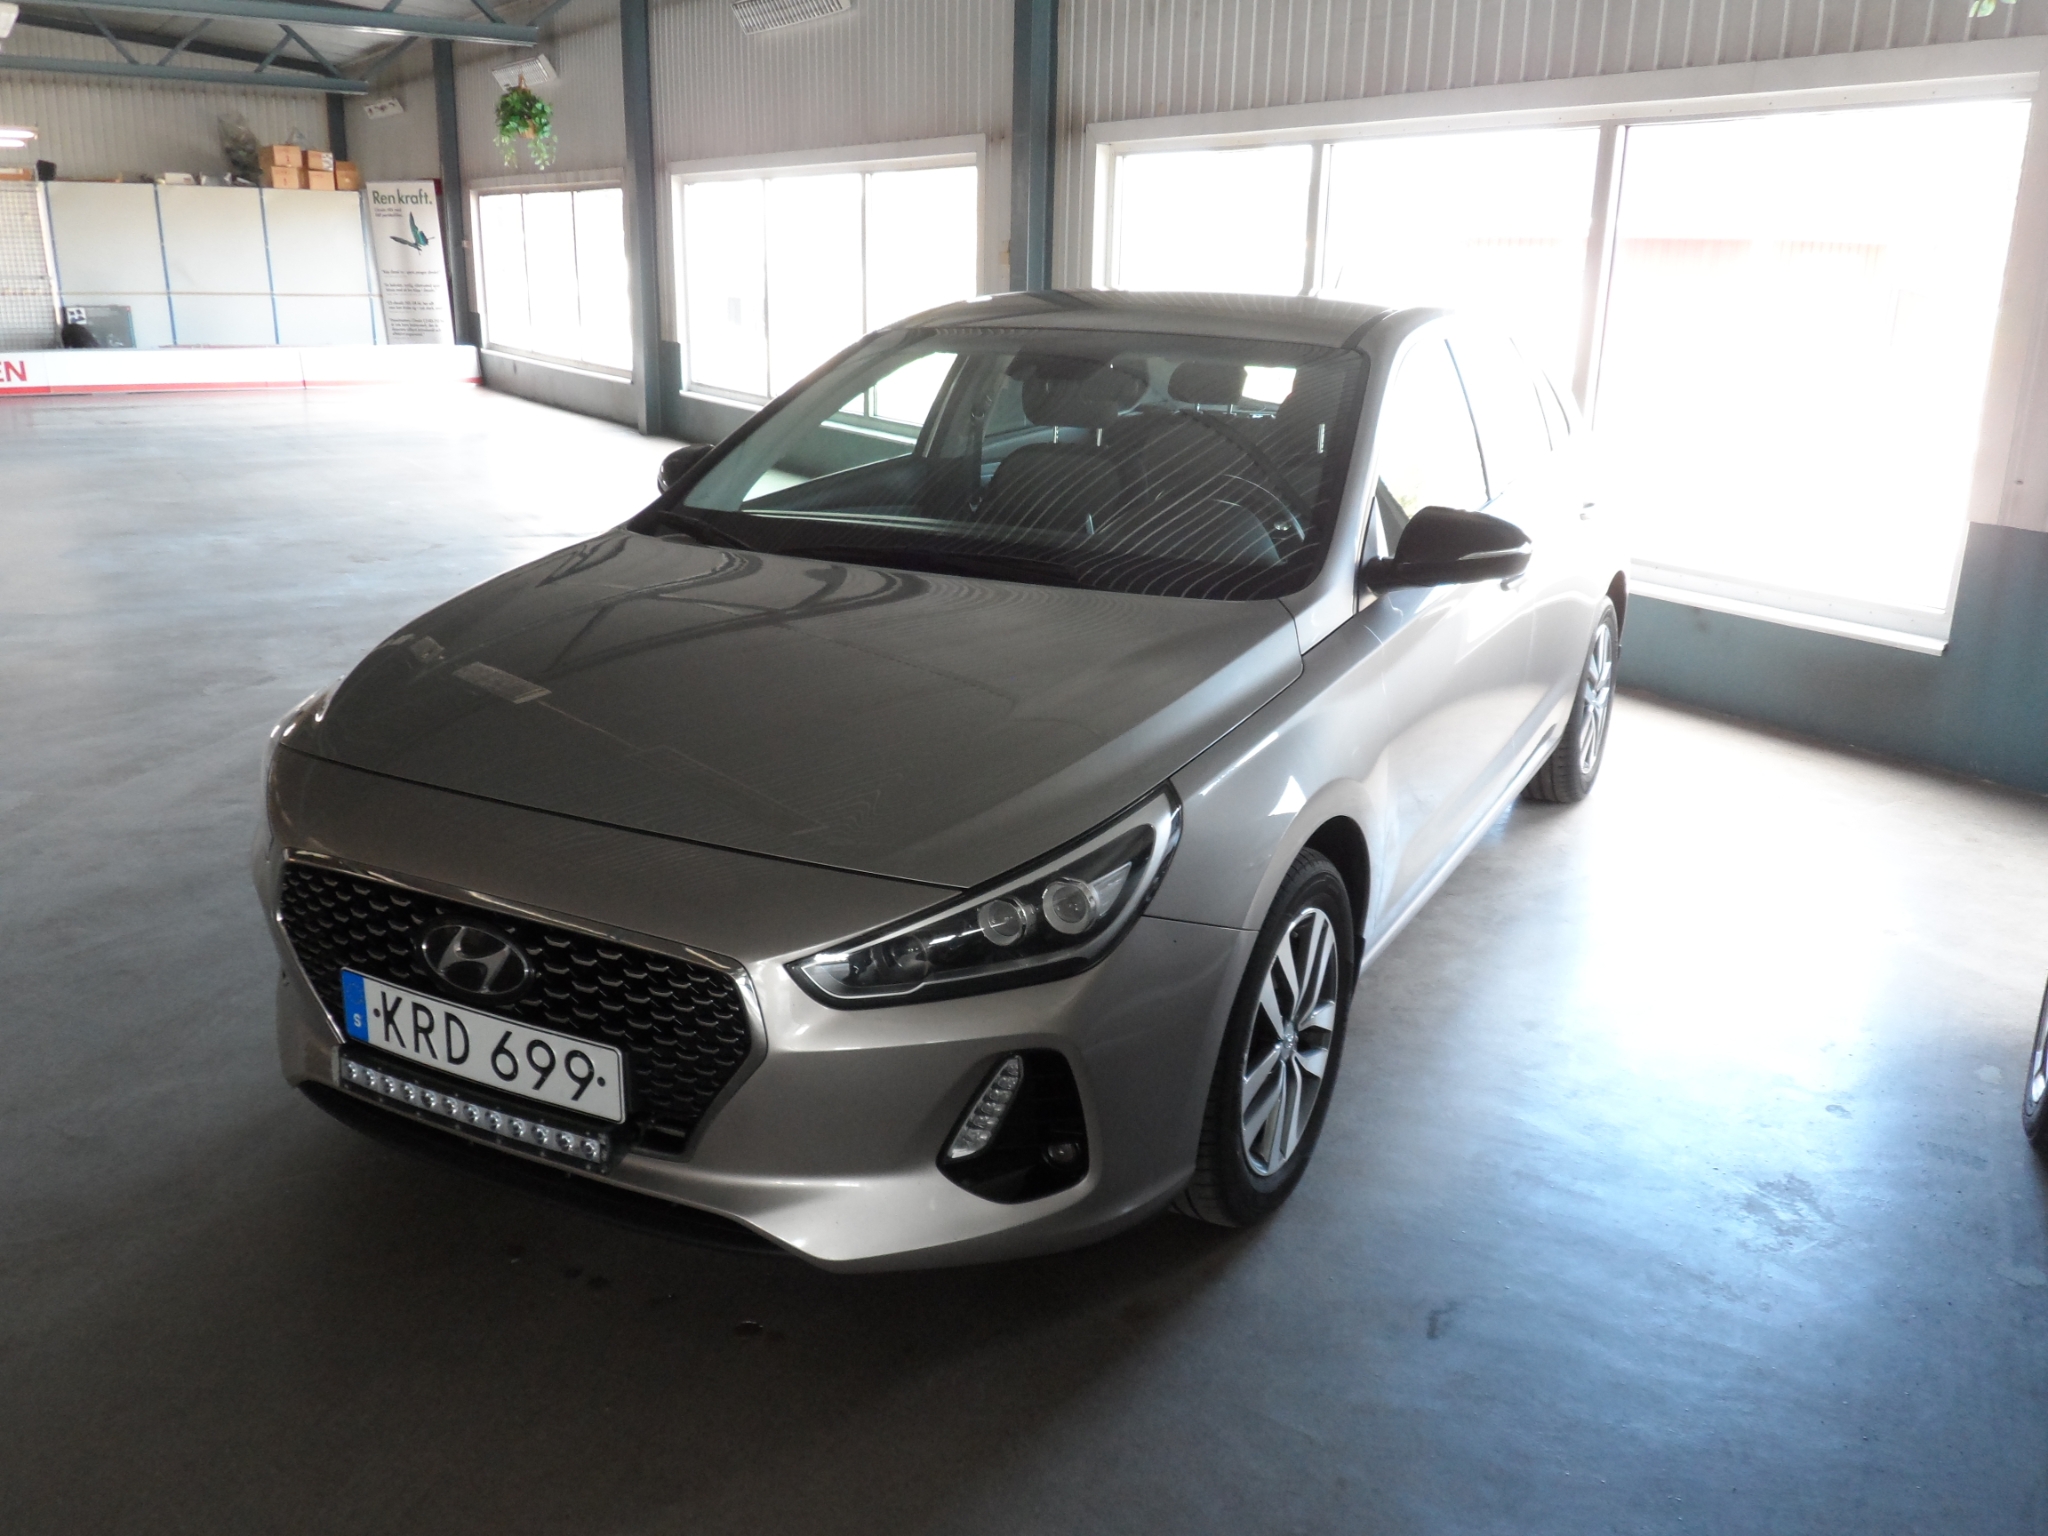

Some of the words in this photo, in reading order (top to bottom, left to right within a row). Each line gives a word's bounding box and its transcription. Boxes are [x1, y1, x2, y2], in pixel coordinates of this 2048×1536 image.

[0, 360, 27, 382] N
[353, 1013, 362, 1028] S
[381, 991, 470, 1065] KRD
[491, 1031, 595, 1101] 699
